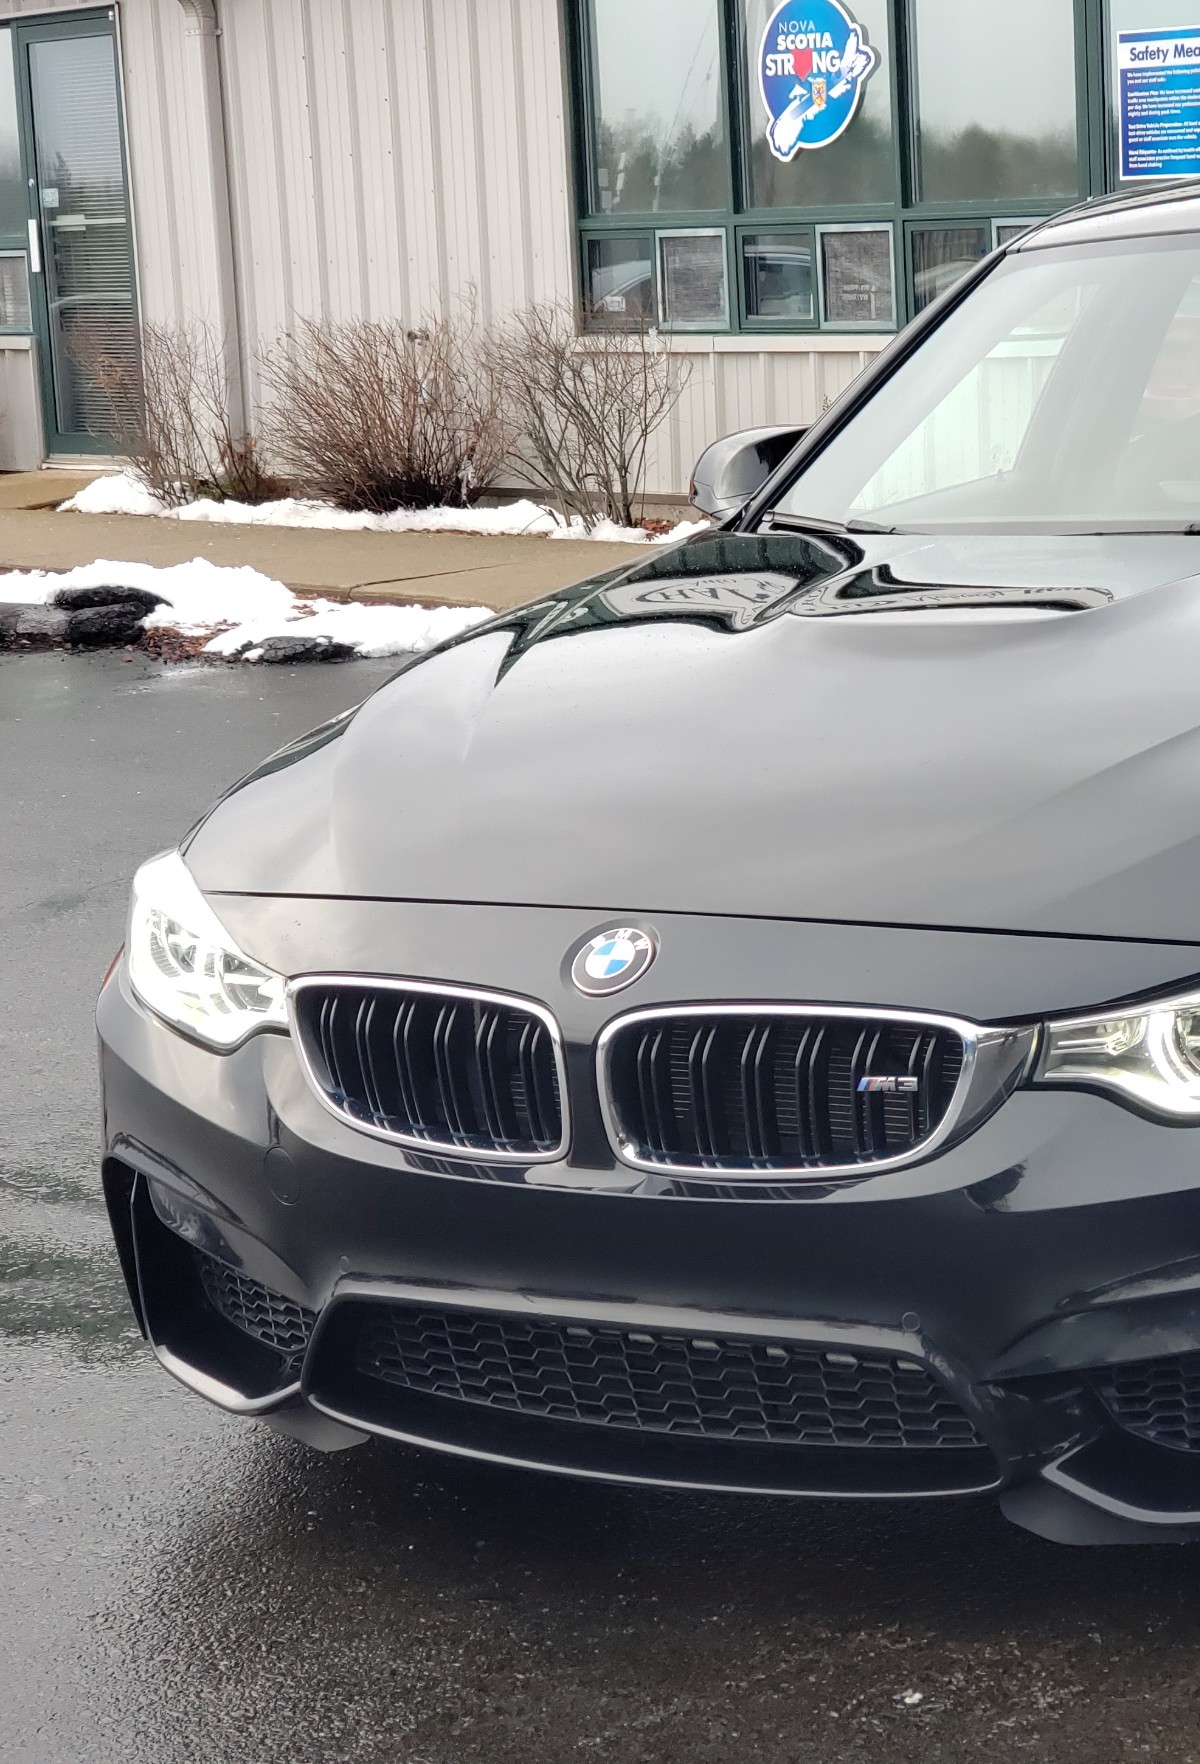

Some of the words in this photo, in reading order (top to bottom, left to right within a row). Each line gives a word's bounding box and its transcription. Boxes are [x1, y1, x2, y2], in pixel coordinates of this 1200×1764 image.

[778, 20, 816, 33] NOVA
[776, 32, 833, 51] SCOTIA
[1130, 45, 1169, 63] Safety
[765, 50, 841, 77] STRNG
